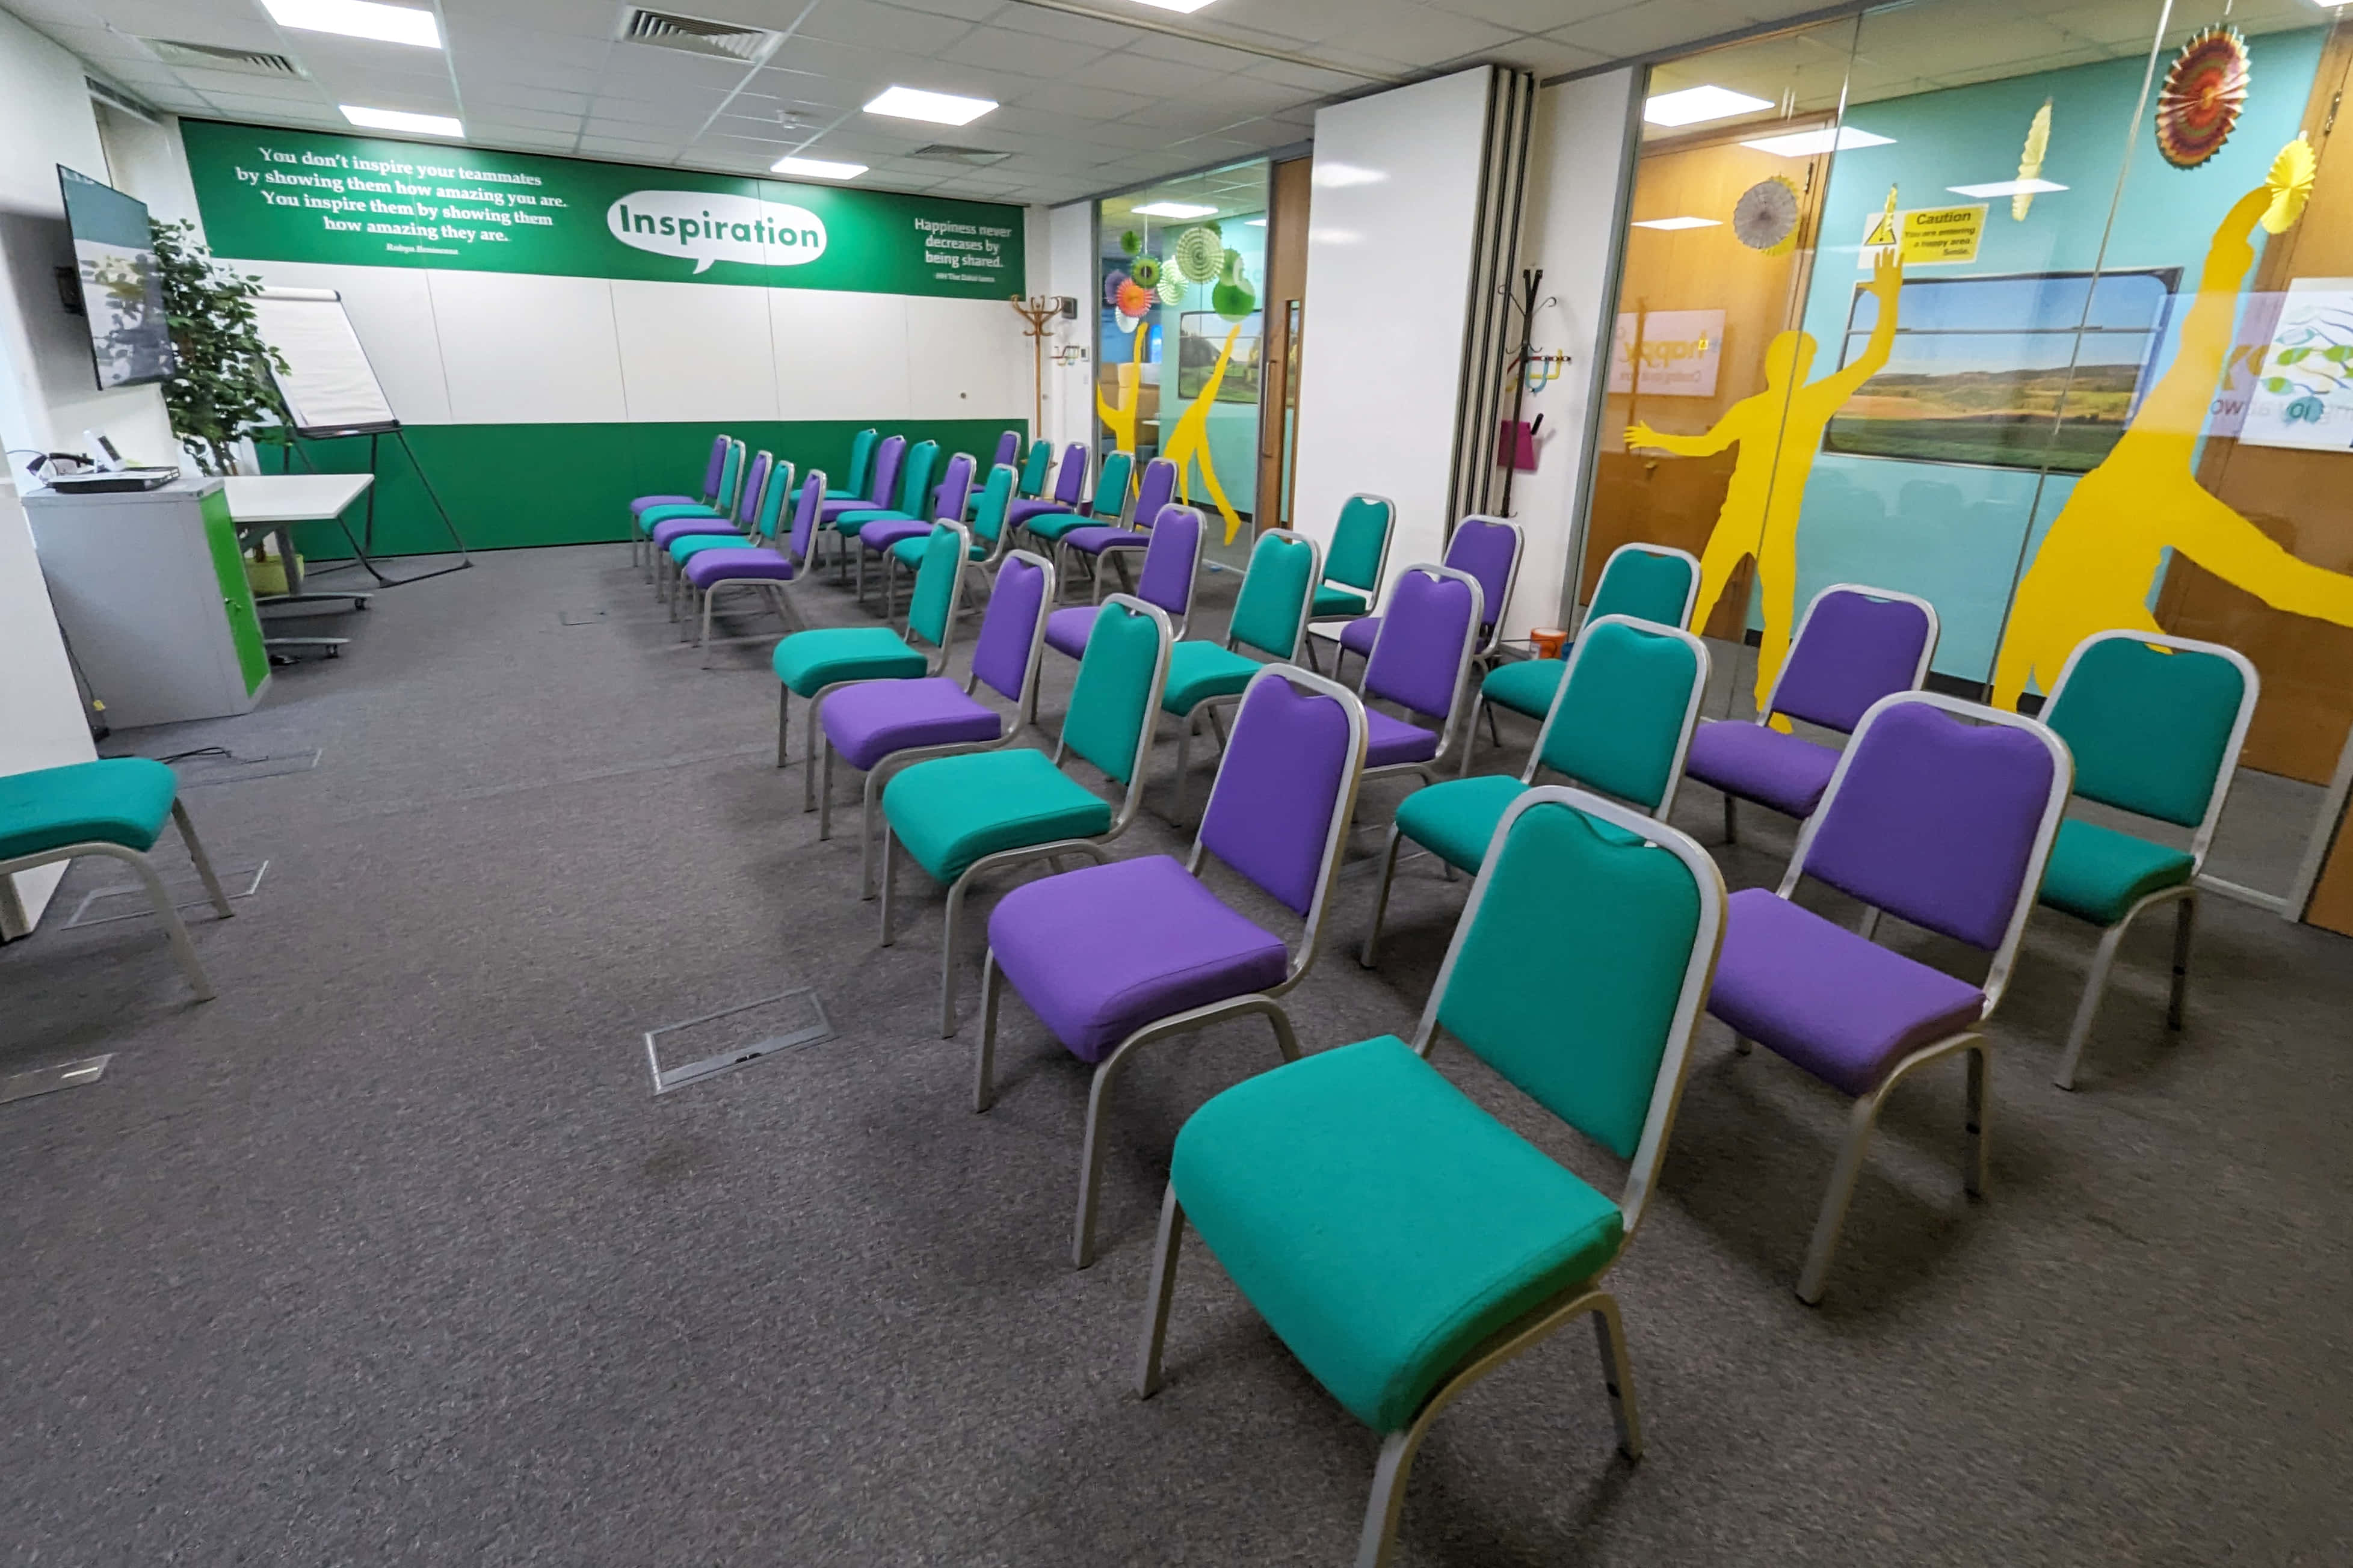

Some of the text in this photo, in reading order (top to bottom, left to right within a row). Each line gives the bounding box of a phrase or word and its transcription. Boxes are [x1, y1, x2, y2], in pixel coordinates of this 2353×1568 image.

[258, 147, 542, 185] You don't inspire your teammates
[234, 166, 567, 208] by showing them how amazing you are.
[261, 190, 554, 226] You inspire them by showing them
[1917, 212, 1971, 225] Caution
[322, 215, 510, 242] how amazing they are.
[619, 204, 819, 248] Inspiration
[914, 218, 1012, 237] Happiness never
[925, 235, 999, 255] decreases by
[925, 250, 1004, 268] being shared.
